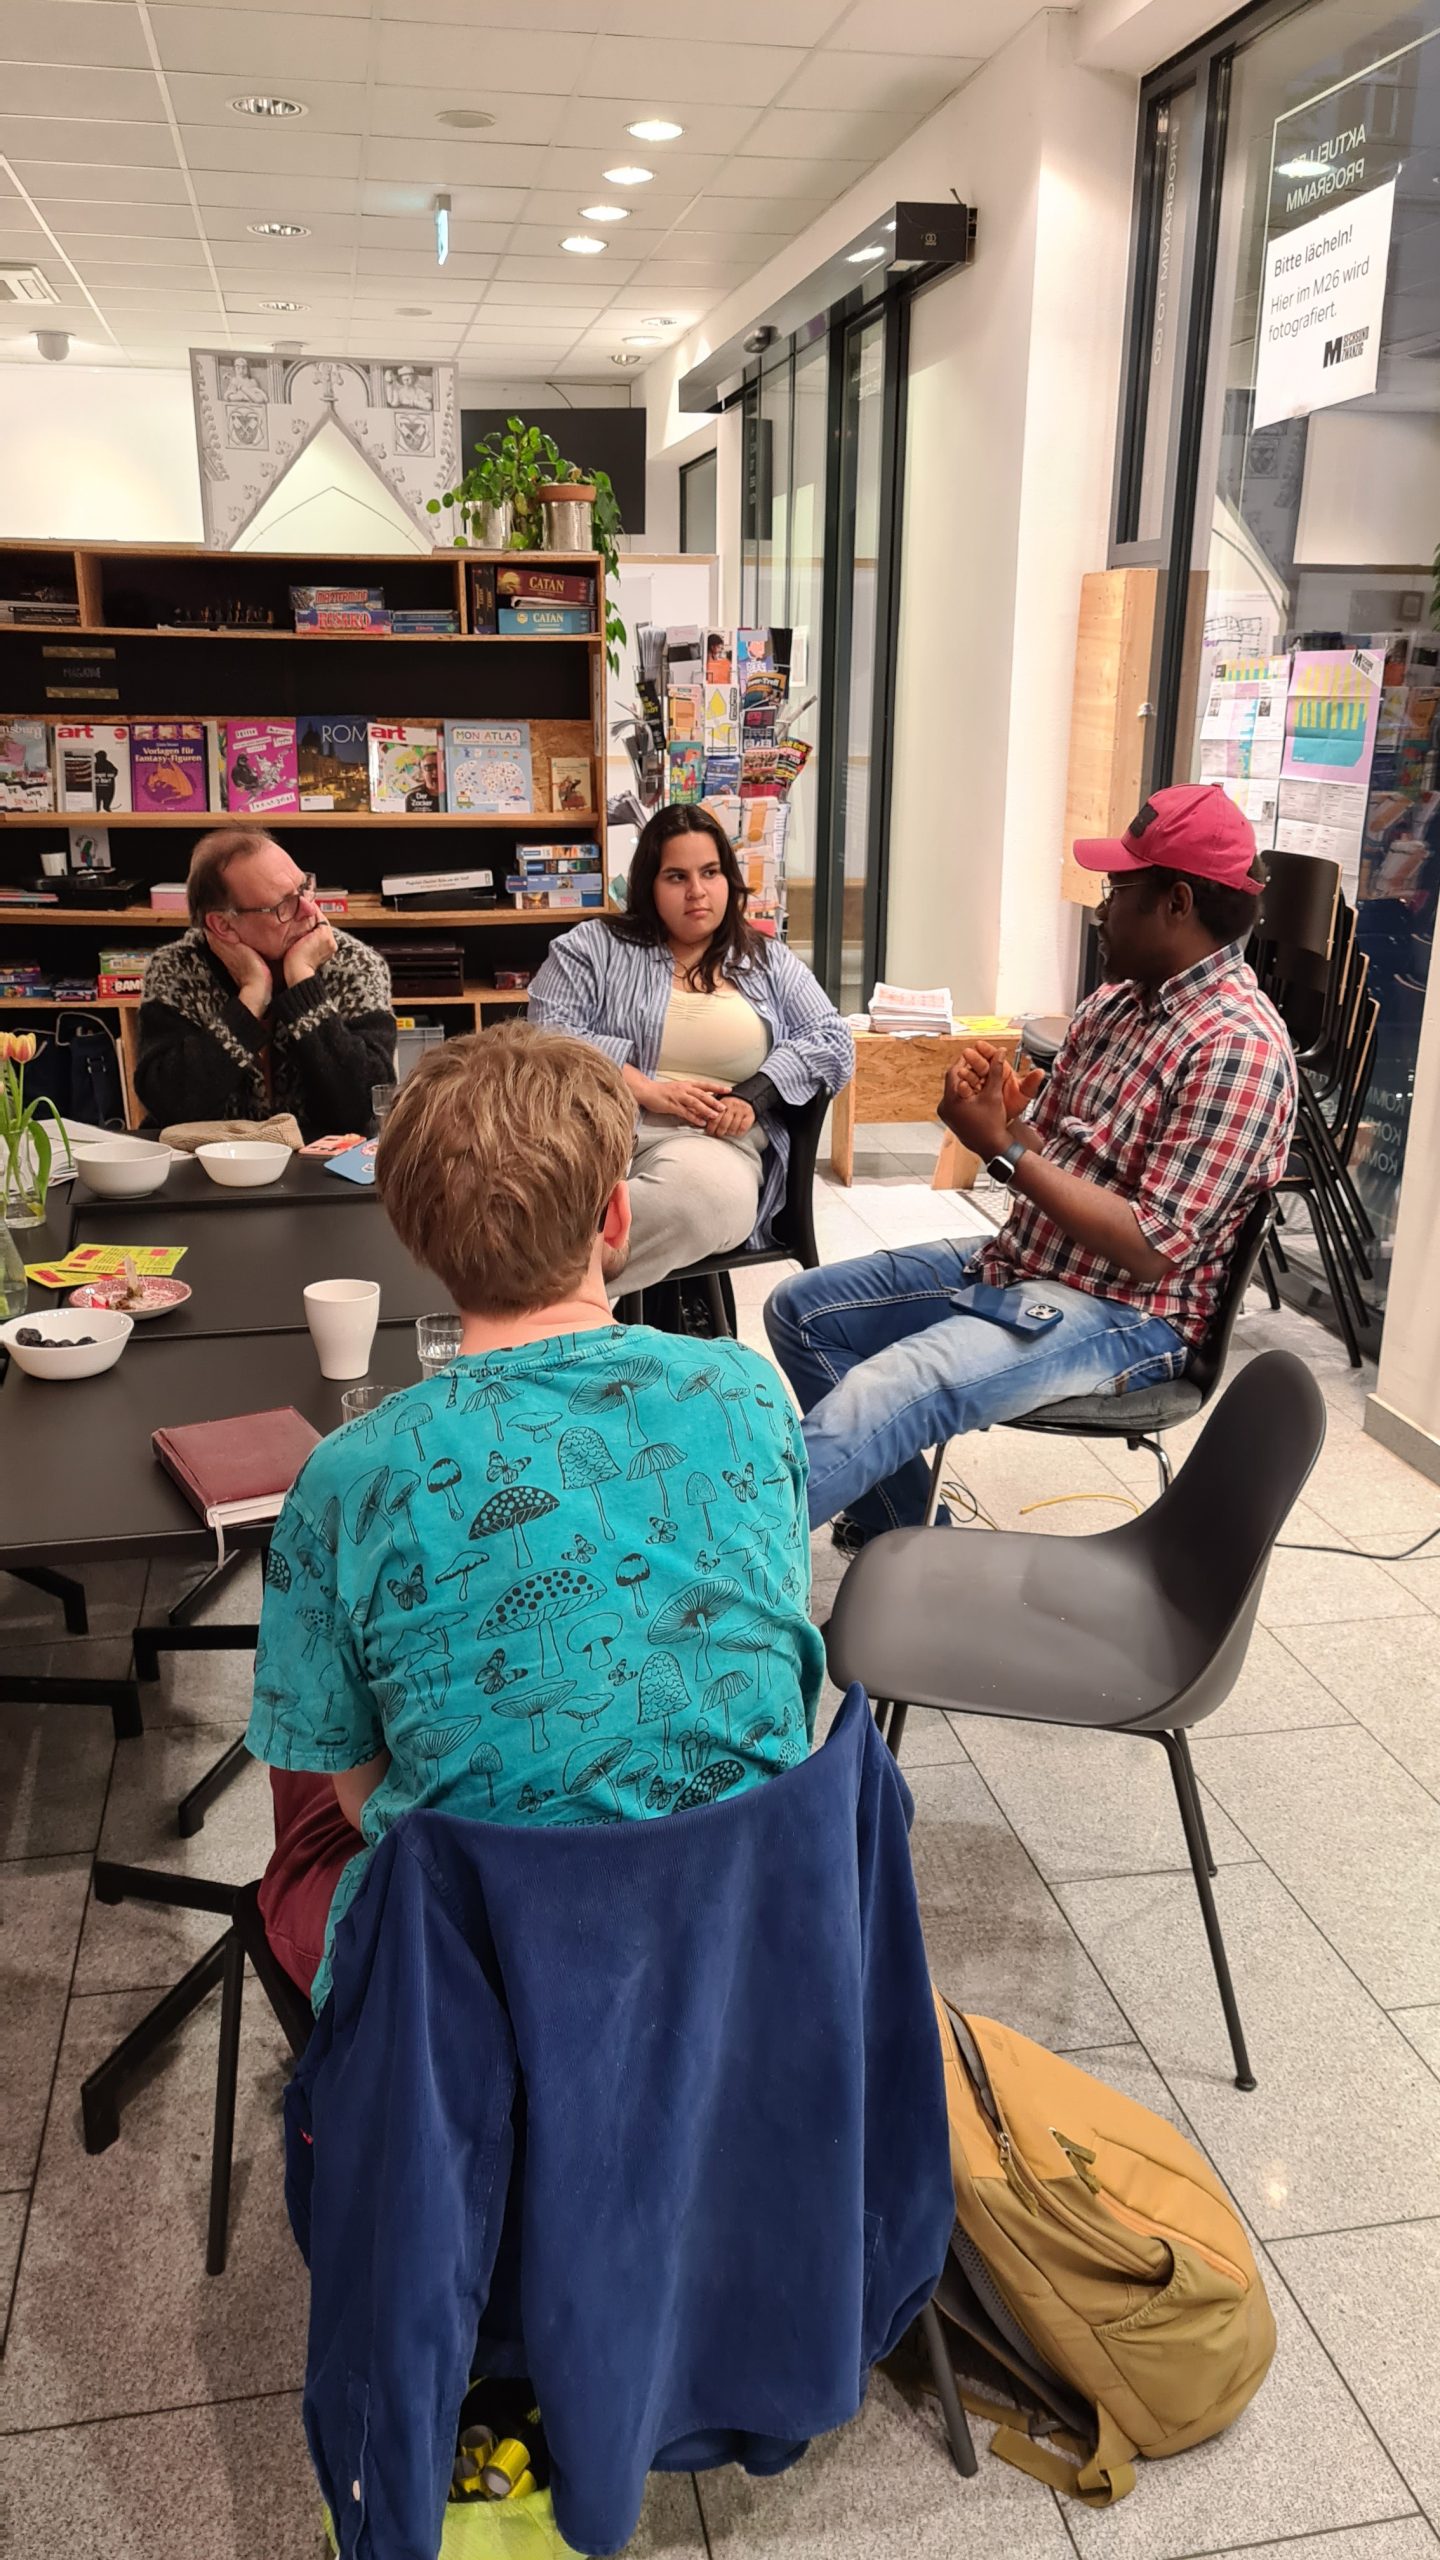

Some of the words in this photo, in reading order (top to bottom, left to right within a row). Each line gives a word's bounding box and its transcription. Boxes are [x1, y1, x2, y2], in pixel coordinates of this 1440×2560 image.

[1273, 252, 1302, 278] Bitte
[1304, 224, 1353, 264] lächeln!
[1270, 293, 1295, 315] Hier
[1296, 286, 1311, 304] im
[1312, 269, 1340, 297] M26
[1342, 255, 1370, 284] wird
[1268, 301, 1338, 343] fotografiert.
[1322, 335, 1344, 369] M
[528, 576, 565, 592] CATAN
[532, 612, 564, 623] CATAN
[57, 724, 94, 739] art
[322, 724, 368, 743] ROM
[370, 726, 406, 741] art
[456, 731, 480, 740] MON
[484, 731, 518, 741] ATLAS
[143, 747, 179, 756] Vorlagen
